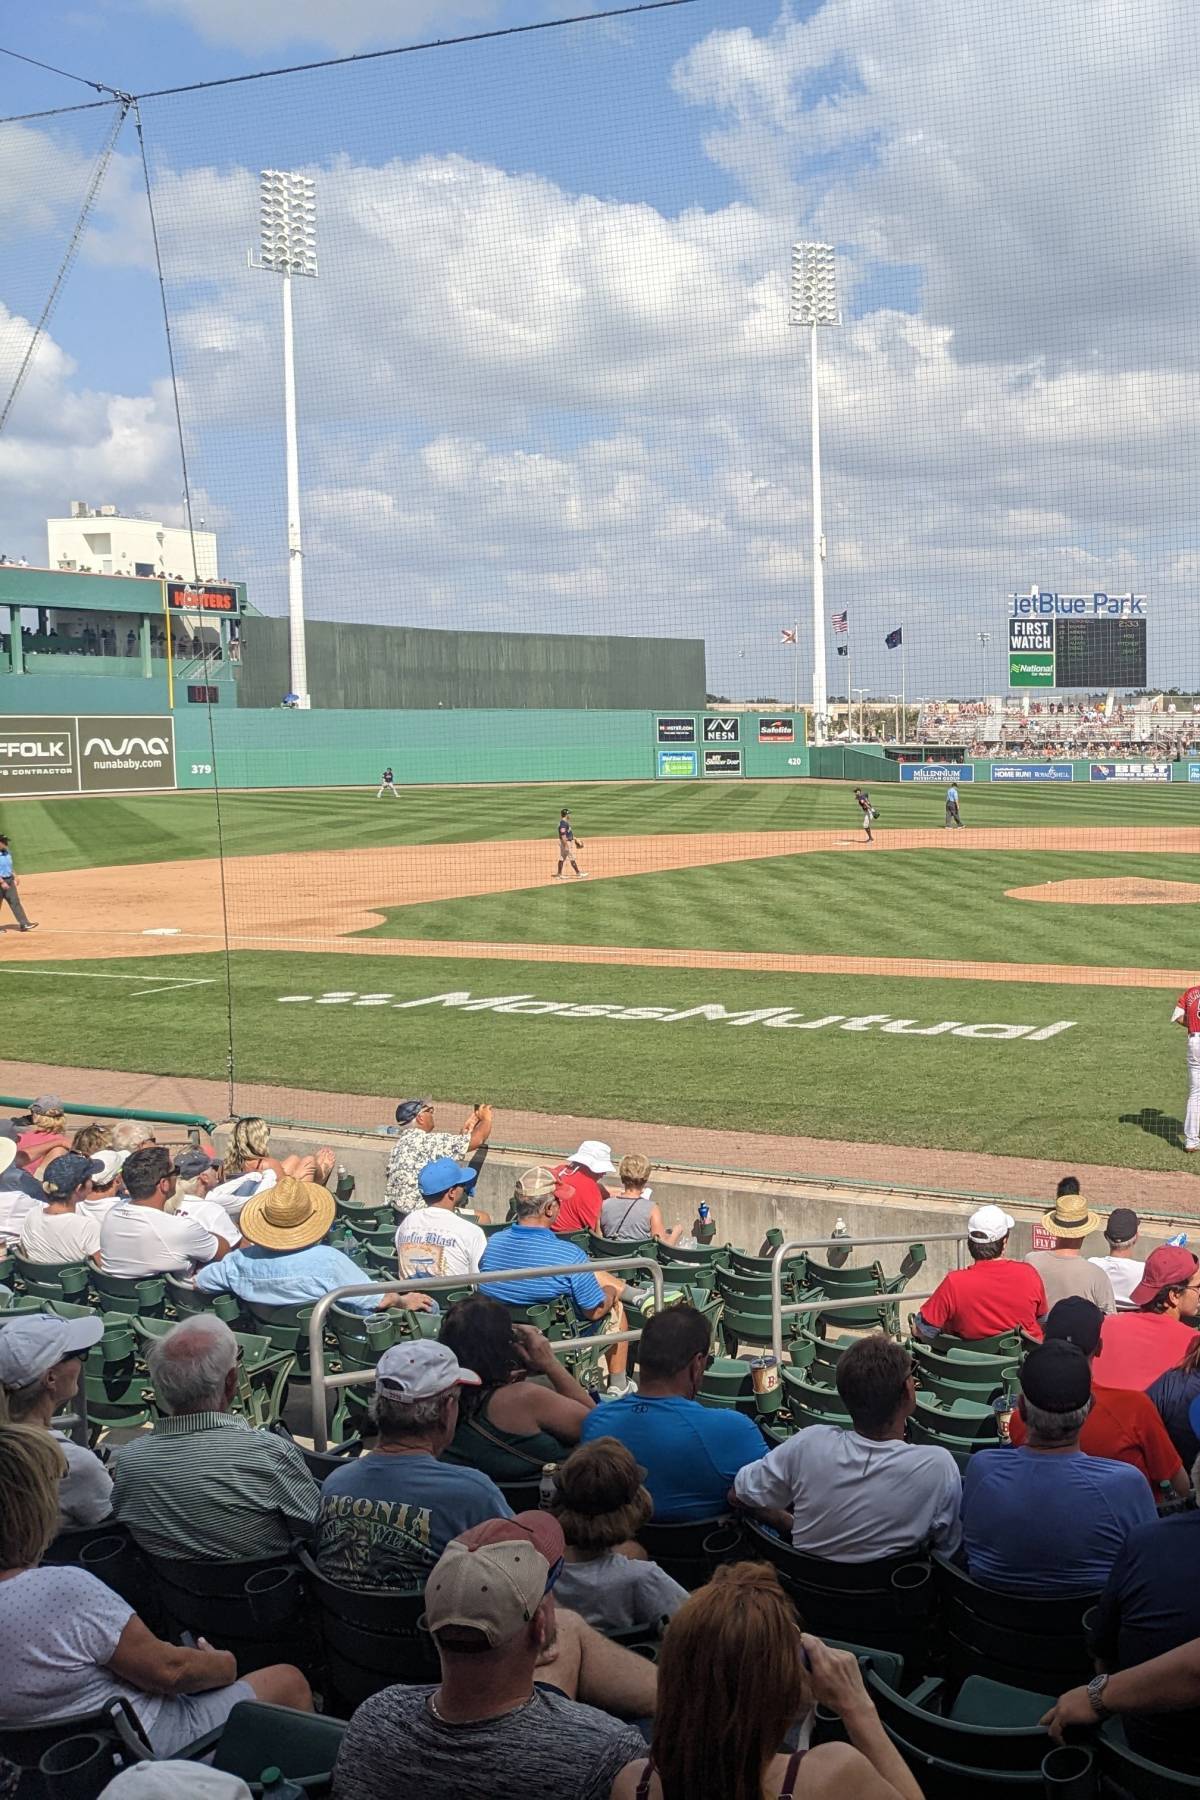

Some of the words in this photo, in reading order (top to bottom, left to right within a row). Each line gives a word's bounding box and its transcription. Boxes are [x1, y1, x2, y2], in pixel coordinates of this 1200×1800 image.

[1013, 593, 1086, 617] jetBlue
[1093, 593, 1143, 614] Park
[1014, 622, 1048, 636] FIRST
[1011, 636, 1051, 649] WATCH
[1020, 664, 1054, 673] National
[708, 732, 735, 740] NESN
[93, 758, 162, 770] nunababy.com
[788, 757, 801, 766] 420
[191, 764, 212, 774] 379
[913, 768, 961, 777] MILLENNIUM
[1115, 765, 1168, 773] BEST
[391, 991, 1078, 1041] MassMutual
[425, 1232, 457, 1247] Blast
